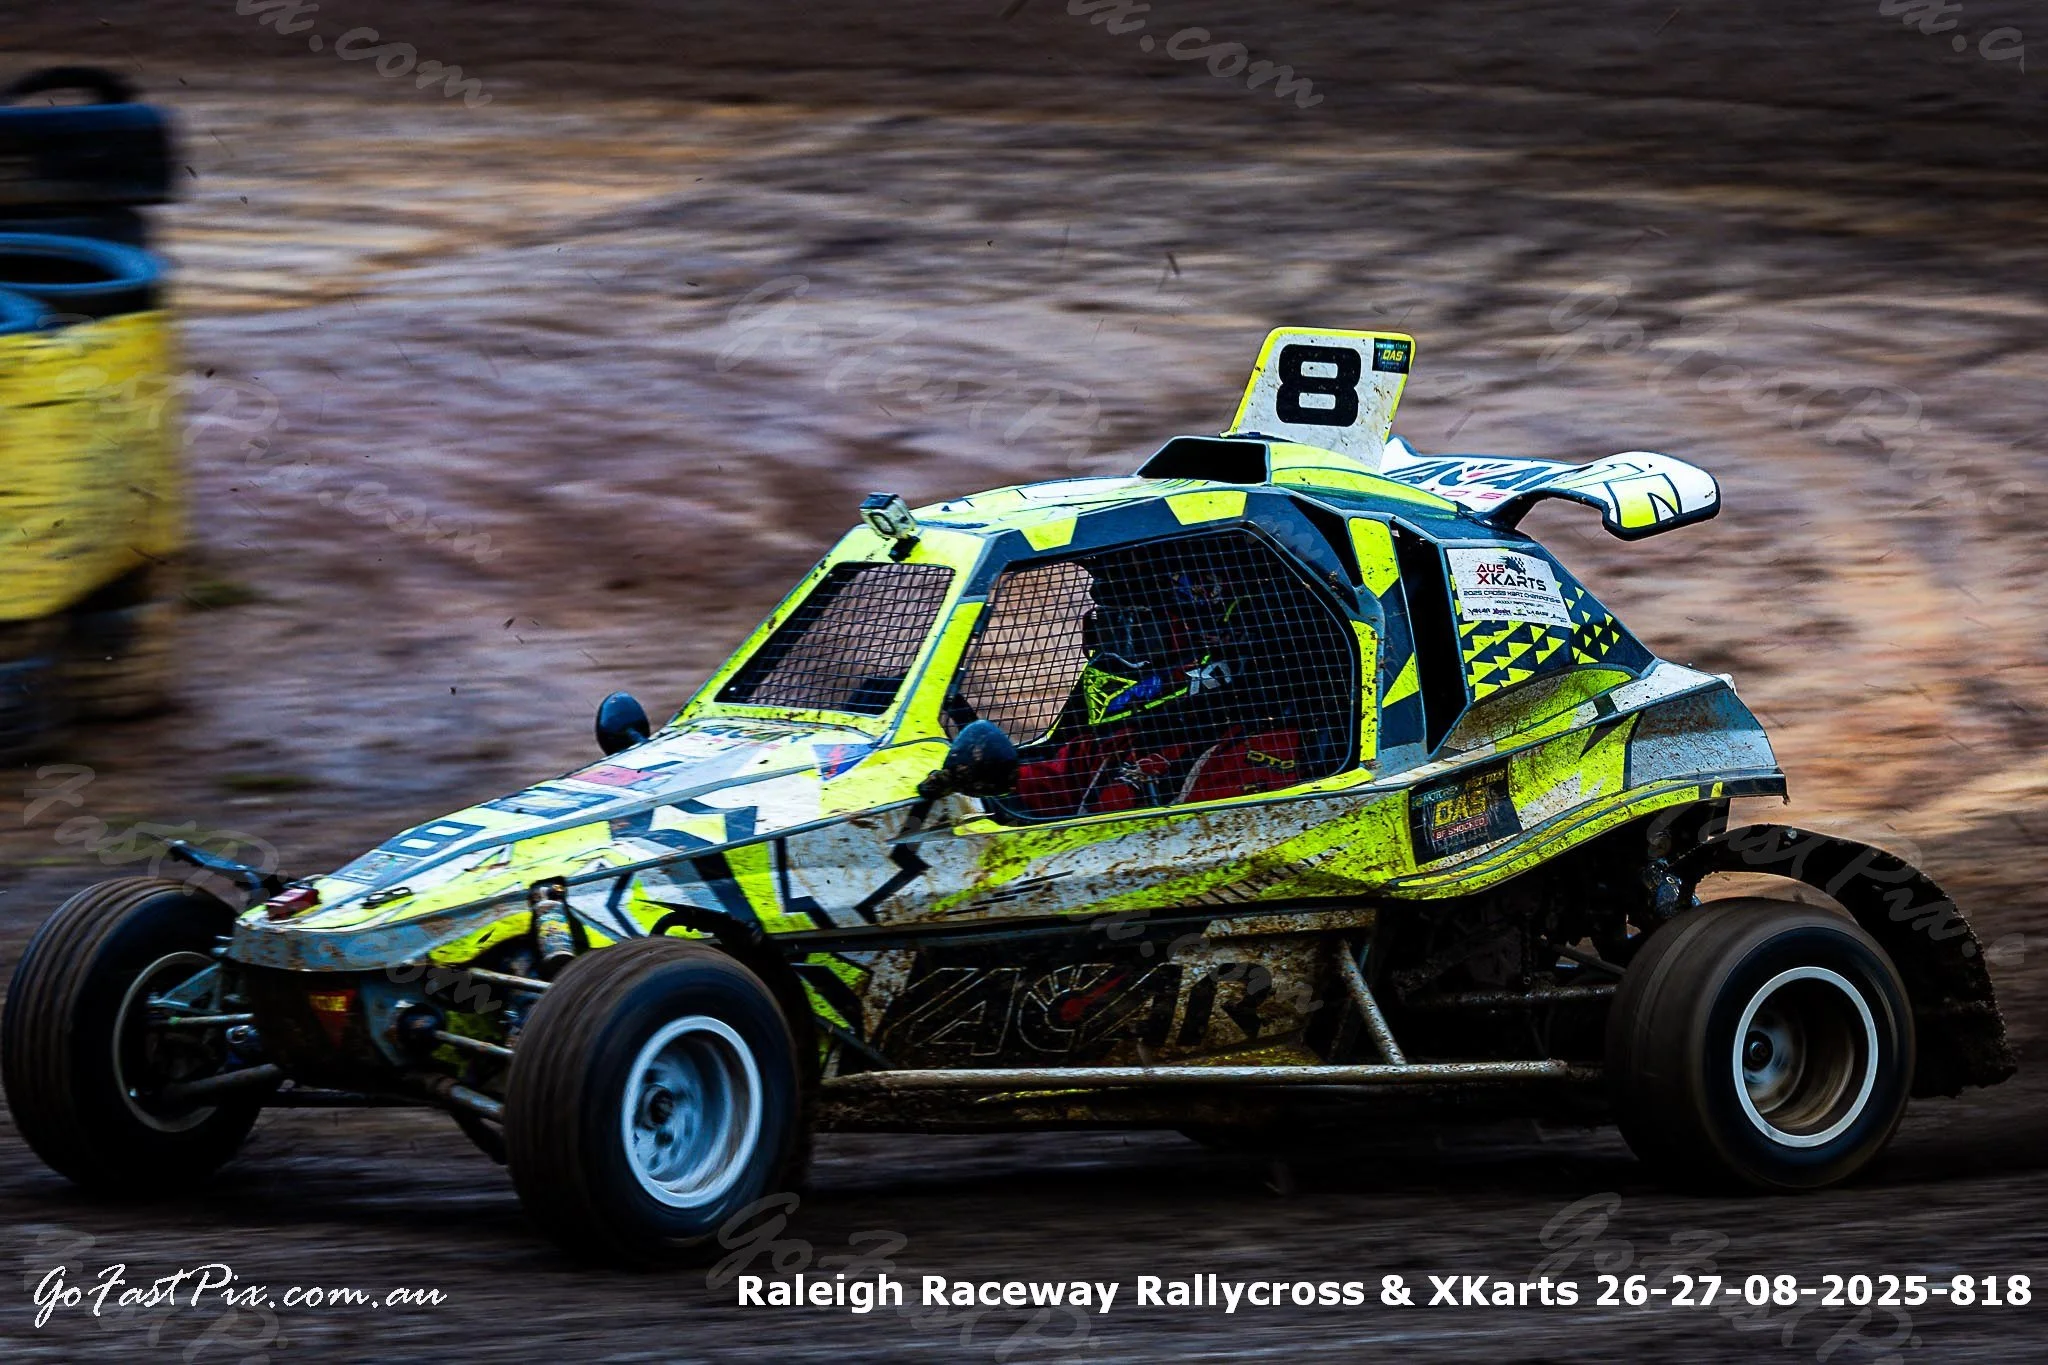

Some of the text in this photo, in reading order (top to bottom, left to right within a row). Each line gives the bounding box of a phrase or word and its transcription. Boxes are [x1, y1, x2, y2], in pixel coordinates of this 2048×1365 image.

[1276, 343, 1362, 428] 8
[1476, 563, 1505, 574] AUS
[1476, 573, 1548, 591] XKARTS
